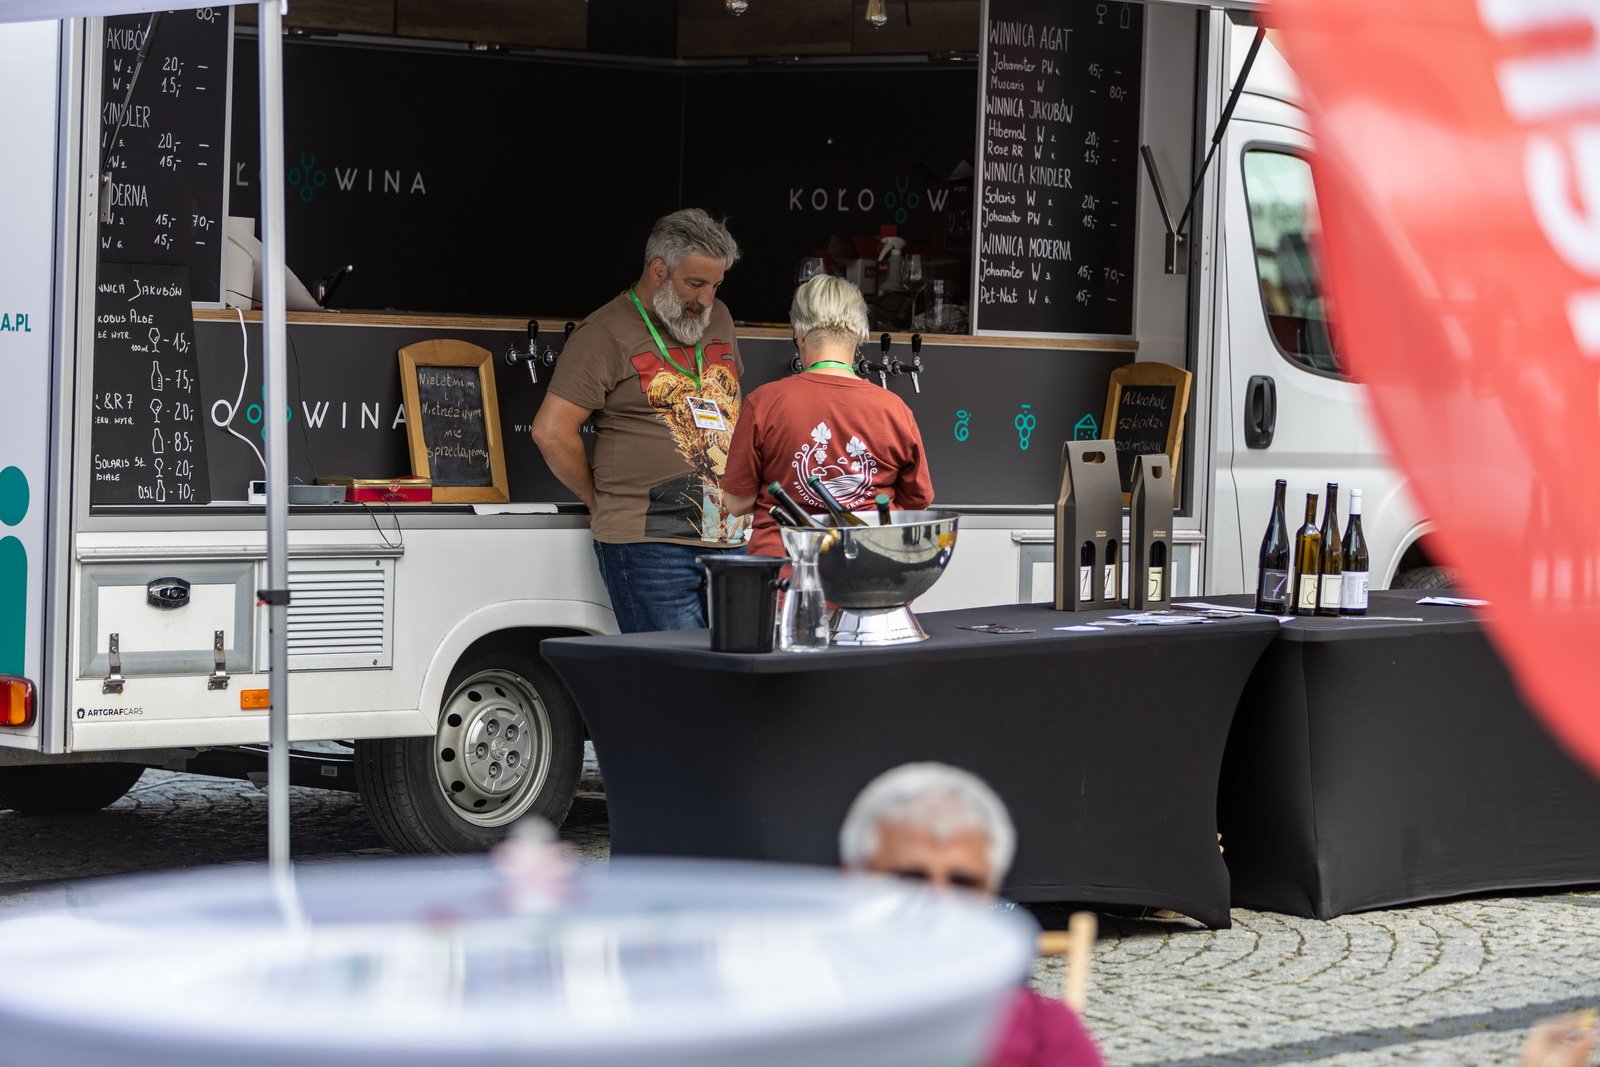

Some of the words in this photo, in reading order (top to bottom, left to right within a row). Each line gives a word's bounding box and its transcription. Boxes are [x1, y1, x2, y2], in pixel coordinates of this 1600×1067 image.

[107, 24, 148, 51] AKUBÓ
[990, 20, 1035, 47] WINNICA
[1040, 26, 1073, 52] AGAT
[114, 58, 122, 72] W
[991, 51, 1036, 74] Johanniter
[113, 77, 121, 90] W
[991, 76, 1025, 91] Muscaris
[1037, 80, 1045, 94] W
[986, 95, 1025, 119] WINNICA
[1028, 99, 1073, 124] JAKUBÓW
[1036, 126, 1045, 143] W
[987, 139, 1009, 156] Rose
[1012, 143, 1023, 157] RR
[1034, 144, 1043, 160] W
[335, 167, 426, 195] WINA
[984, 160, 1025, 184] WINNICA
[1029, 164, 1072, 189] KINDLER
[789, 187, 875, 212] KOŁO
[985, 186, 1016, 204] Solaris
[1026, 190, 1036, 206] W
[192, 214, 215, 231] 70,-
[982, 205, 1022, 228] Johanniter
[1027, 210, 1040, 225] PW
[102, 236, 112, 249] W
[980, 232, 1024, 257] WINNICA
[1028, 237, 1072, 261] MODERNA
[980, 257, 1025, 282] Johanniter
[1031, 262, 1041, 282] W
[980, 285, 1018, 304] Pet-Nat
[1028, 289, 1038, 305] W
[0, 313, 31, 332] A.PL
[87, 706, 144, 717] ARTGRAFCARS
